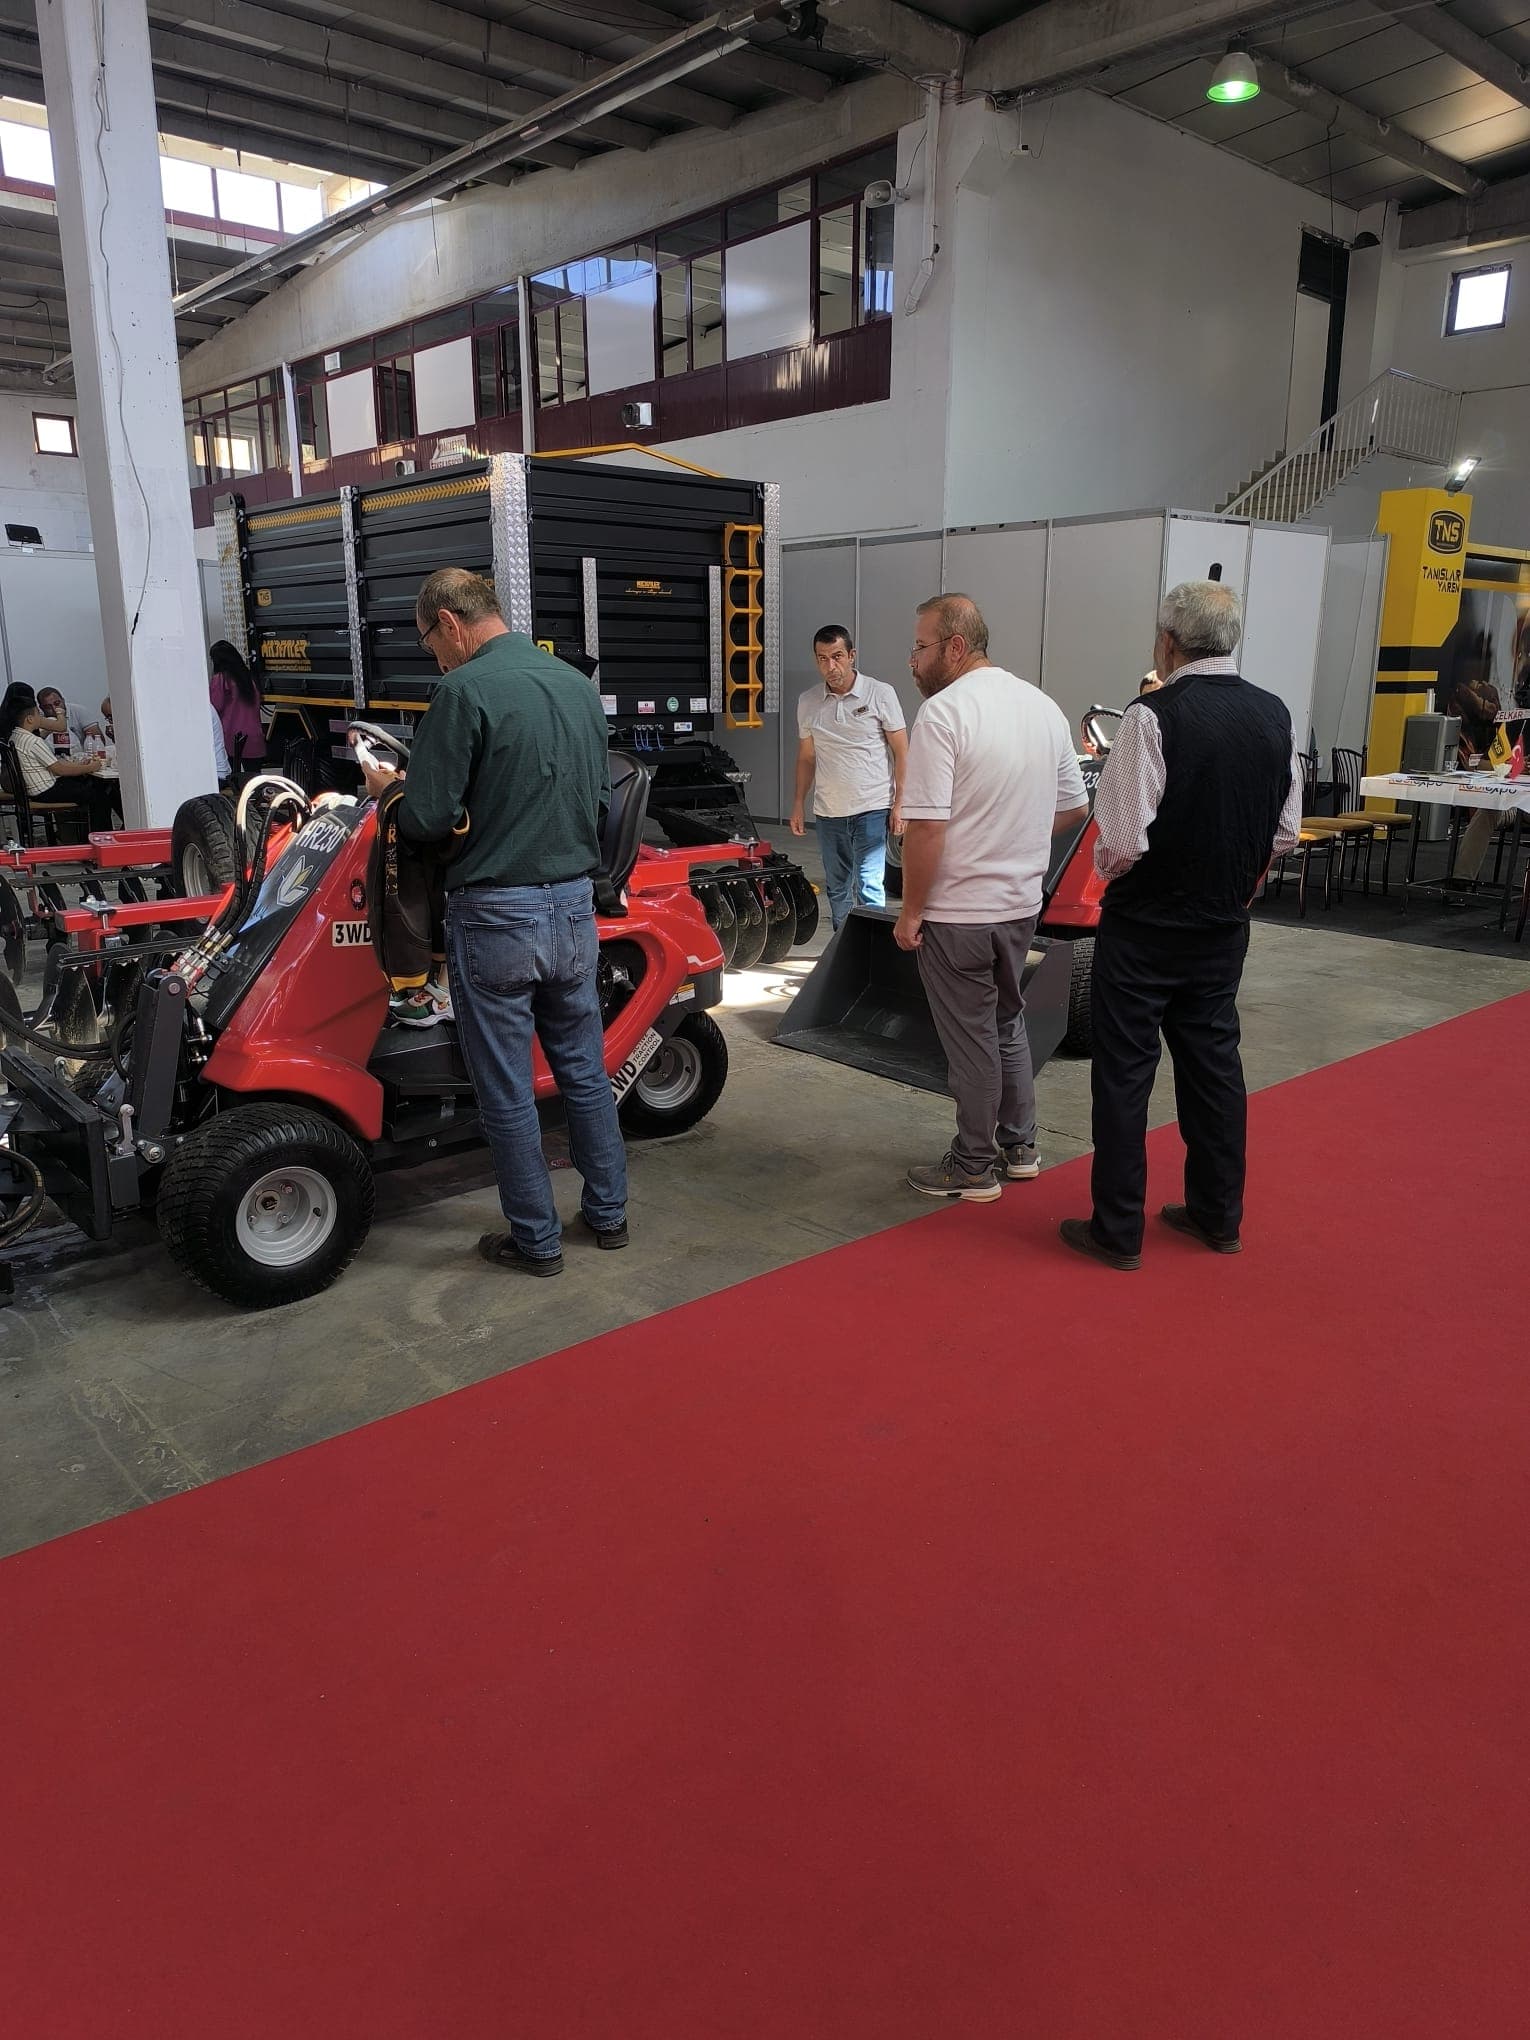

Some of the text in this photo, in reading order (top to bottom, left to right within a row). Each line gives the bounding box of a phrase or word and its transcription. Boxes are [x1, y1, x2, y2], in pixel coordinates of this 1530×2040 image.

[1434, 519, 1460, 542] TNS
[296, 820, 346, 853] HR230
[633, 1031, 656, 1063] TRACTION
[638, 1038, 660, 1066] CONTROL
